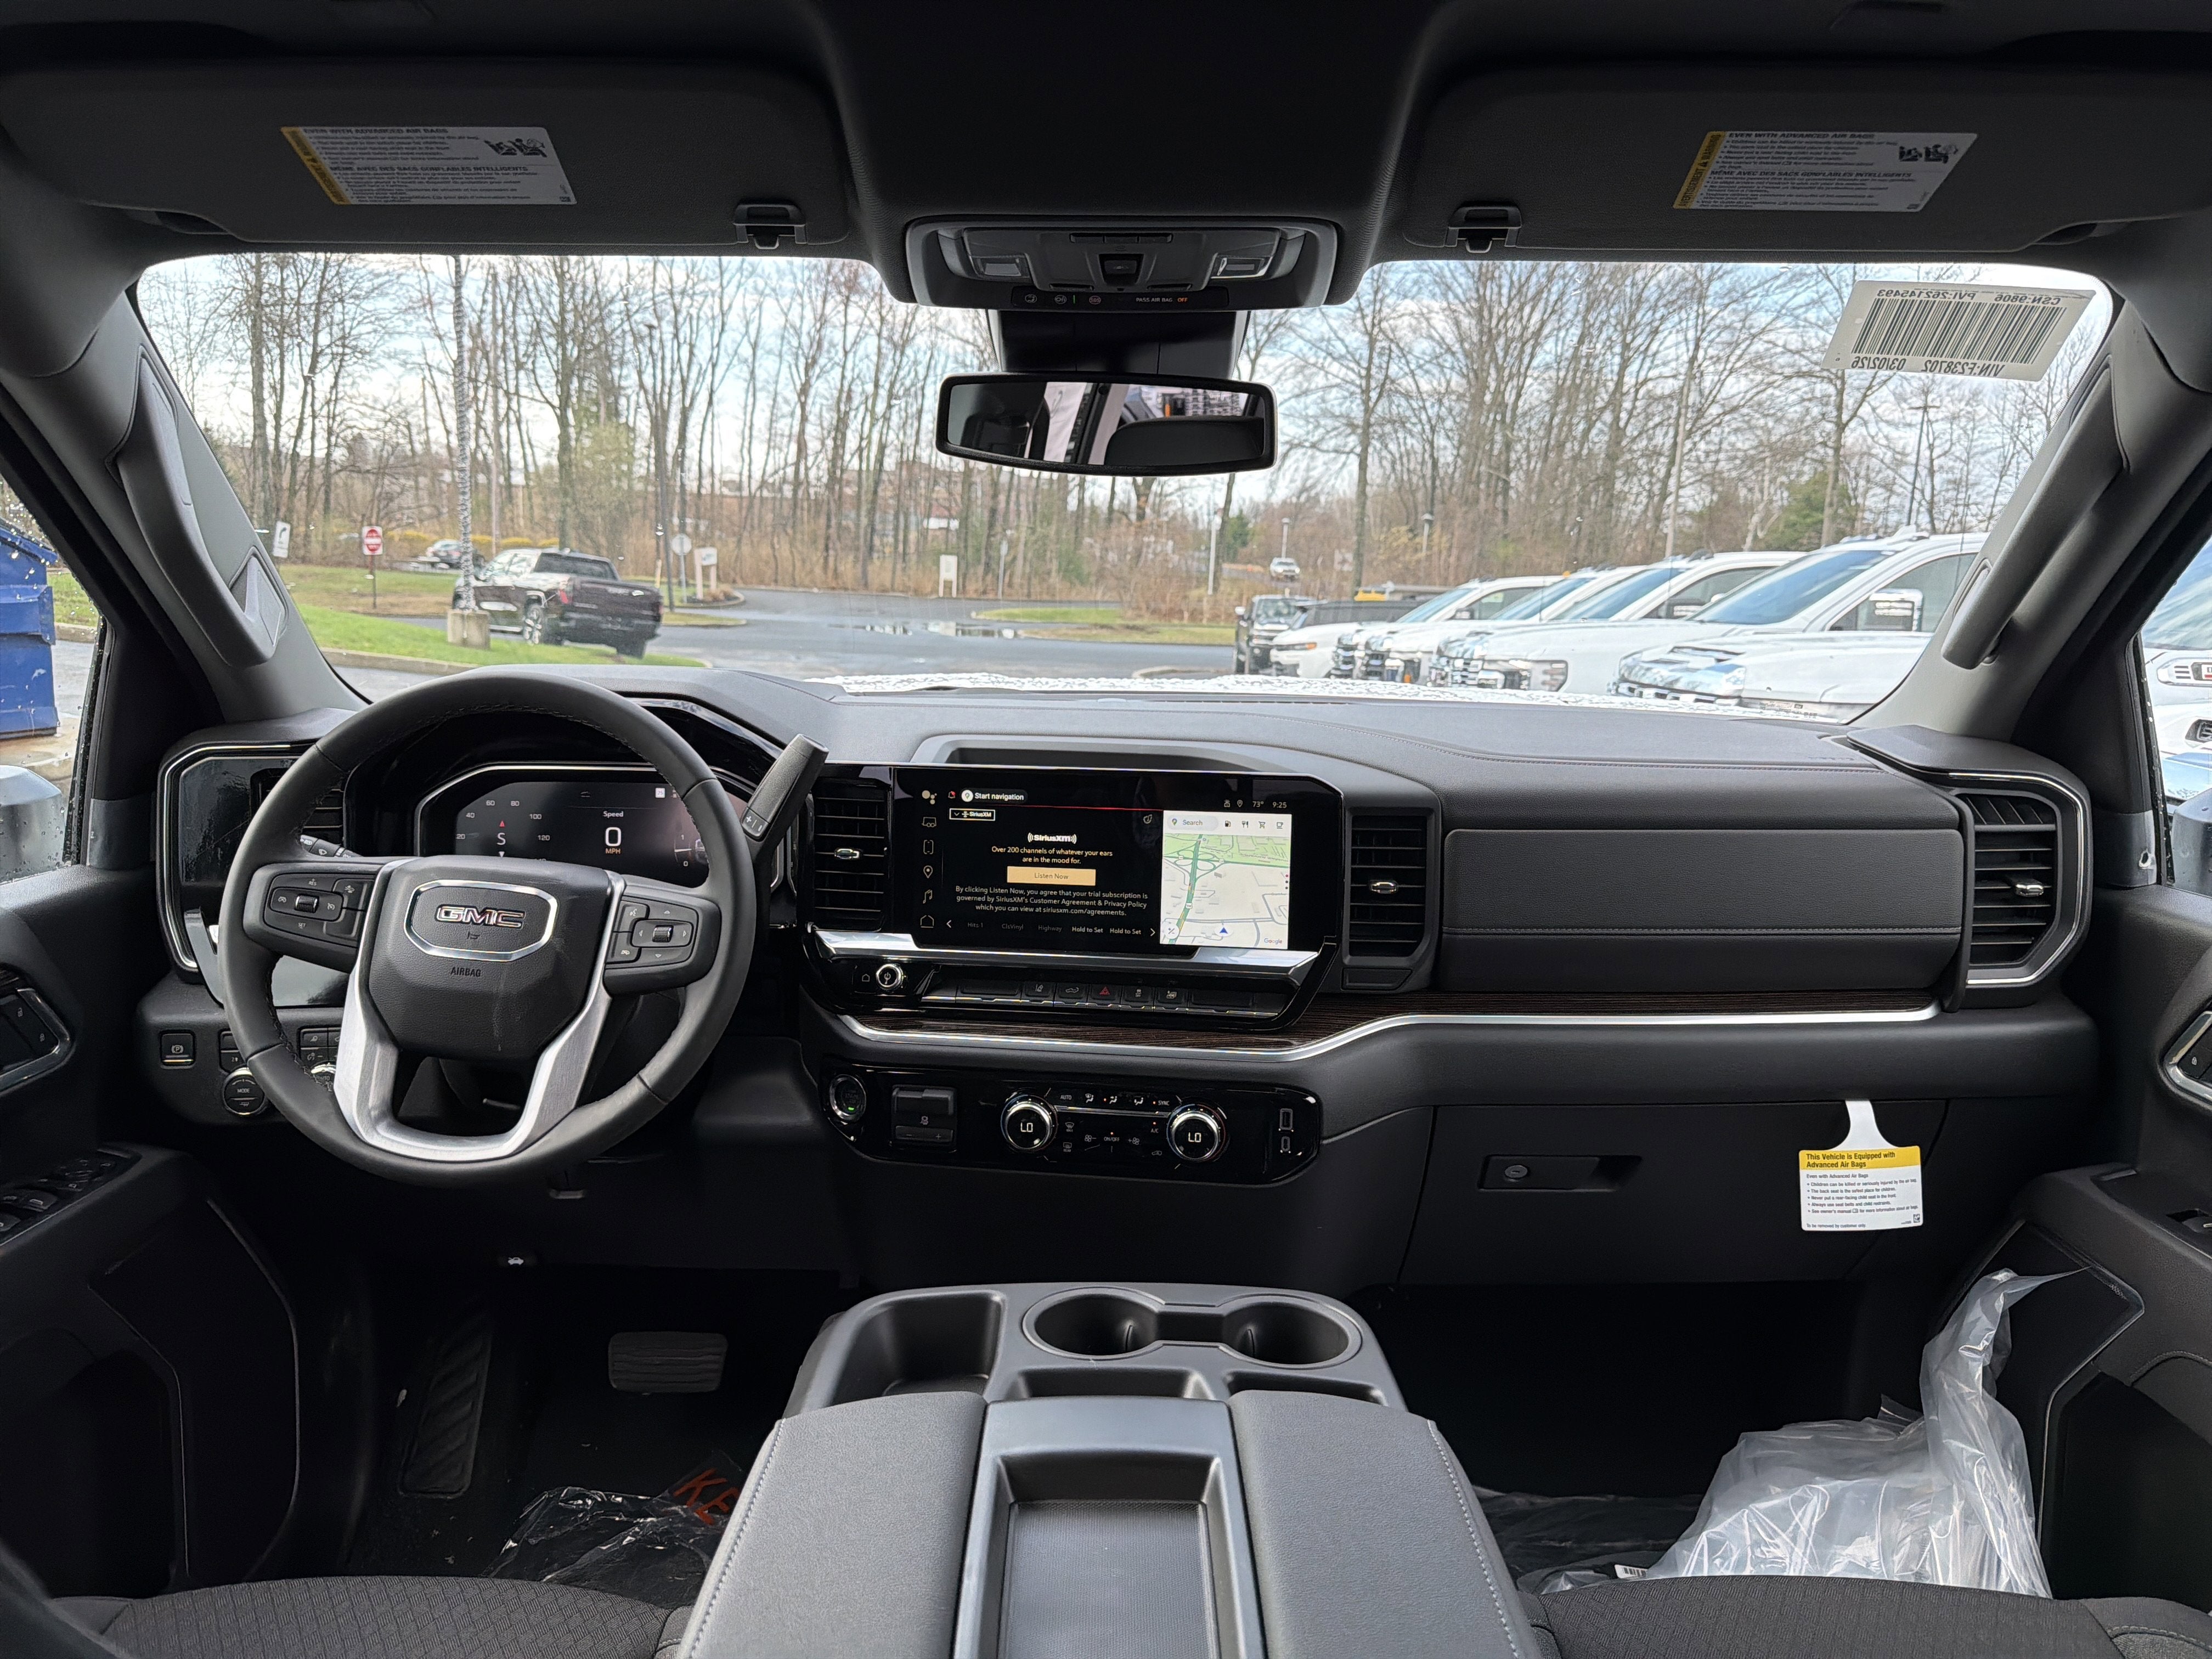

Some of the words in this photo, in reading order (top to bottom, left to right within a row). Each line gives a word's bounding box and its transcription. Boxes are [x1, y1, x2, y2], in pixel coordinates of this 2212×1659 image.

[496, 832, 506, 845] S
[605, 827, 622, 847] 0
[965, 886, 988, 894] clicking
[1102, 891, 1141, 900] subscription
[1104, 900, 1127, 909] Privacy
[1128, 901, 1147, 910] Policy
[435, 904, 526, 929] GMC
[1043, 907, 1127, 916] siriusxm.com/agreements.
[450, 967, 481, 977] AIRBAG
[1854, 1152, 1882, 1160] Equipped
